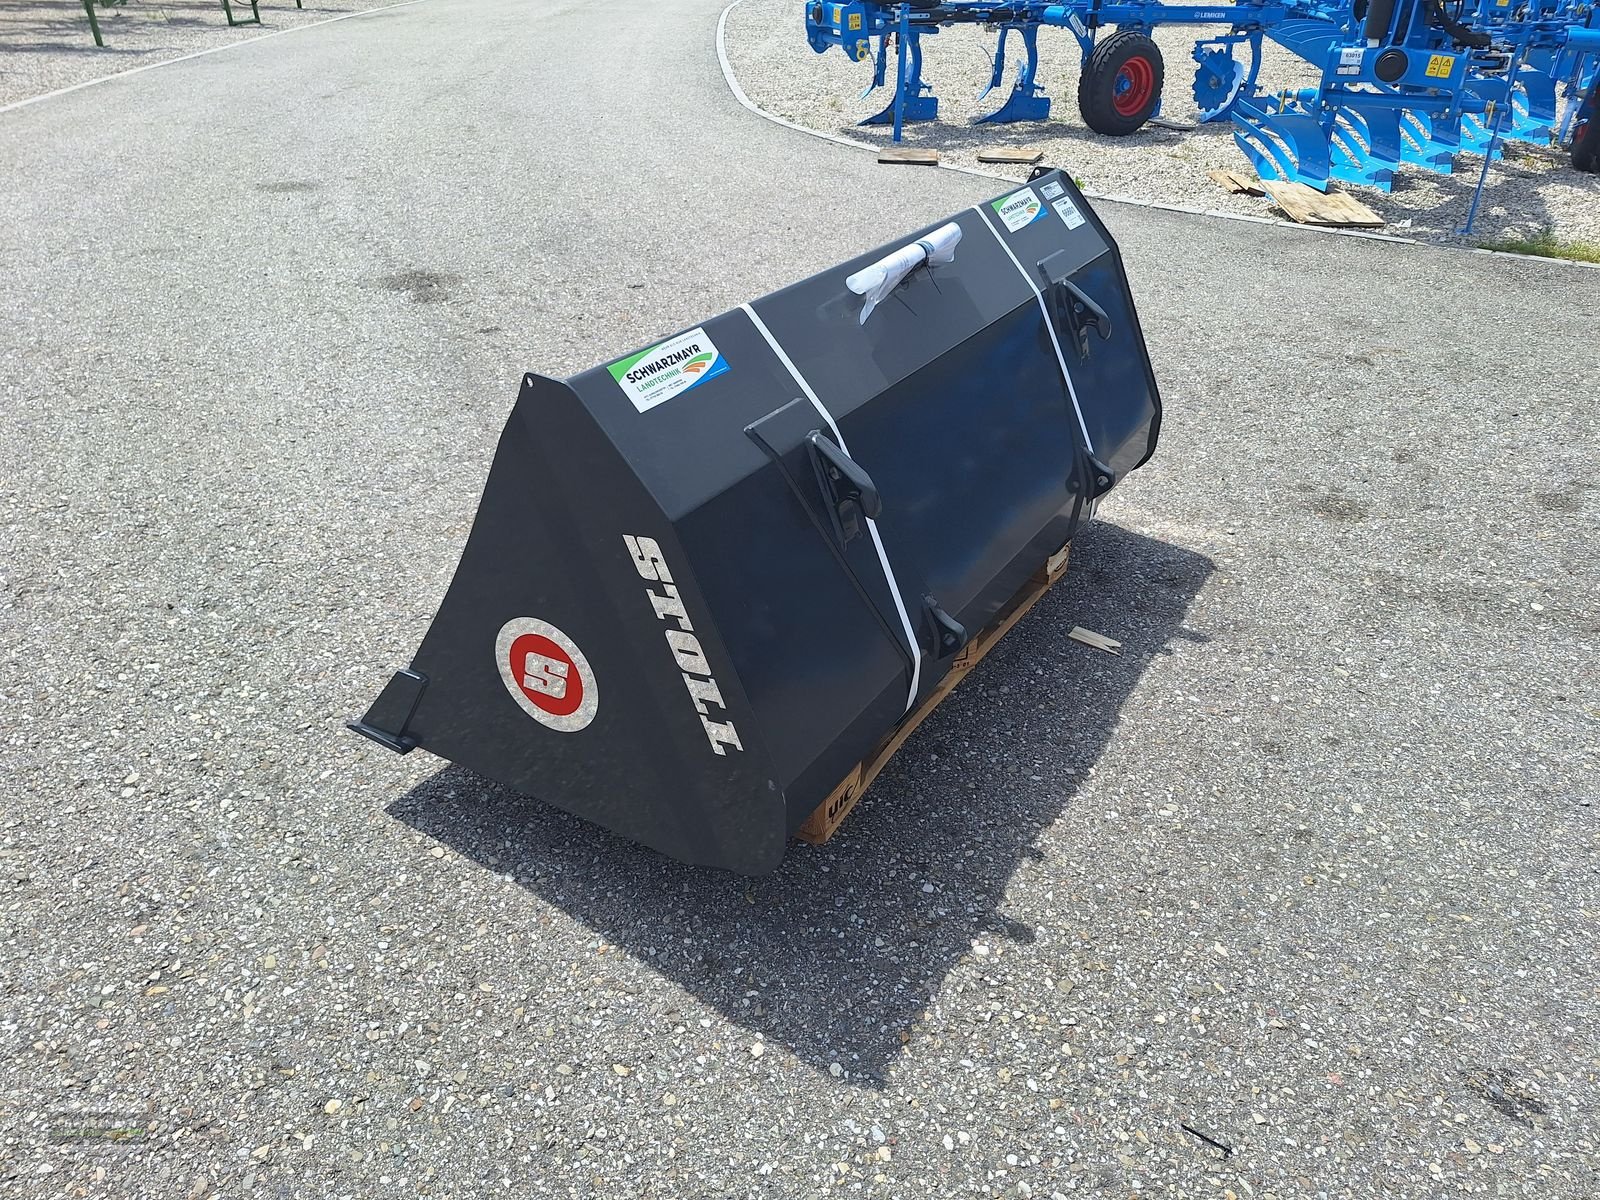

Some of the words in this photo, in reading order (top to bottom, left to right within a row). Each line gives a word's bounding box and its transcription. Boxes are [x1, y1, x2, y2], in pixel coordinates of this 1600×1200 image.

[626, 344, 701, 384] SCHWARZMAYR
[636, 368, 681, 393] LANDTECHNIK
[622, 534, 744, 756] STOLL
[523, 651, 569, 700] S
